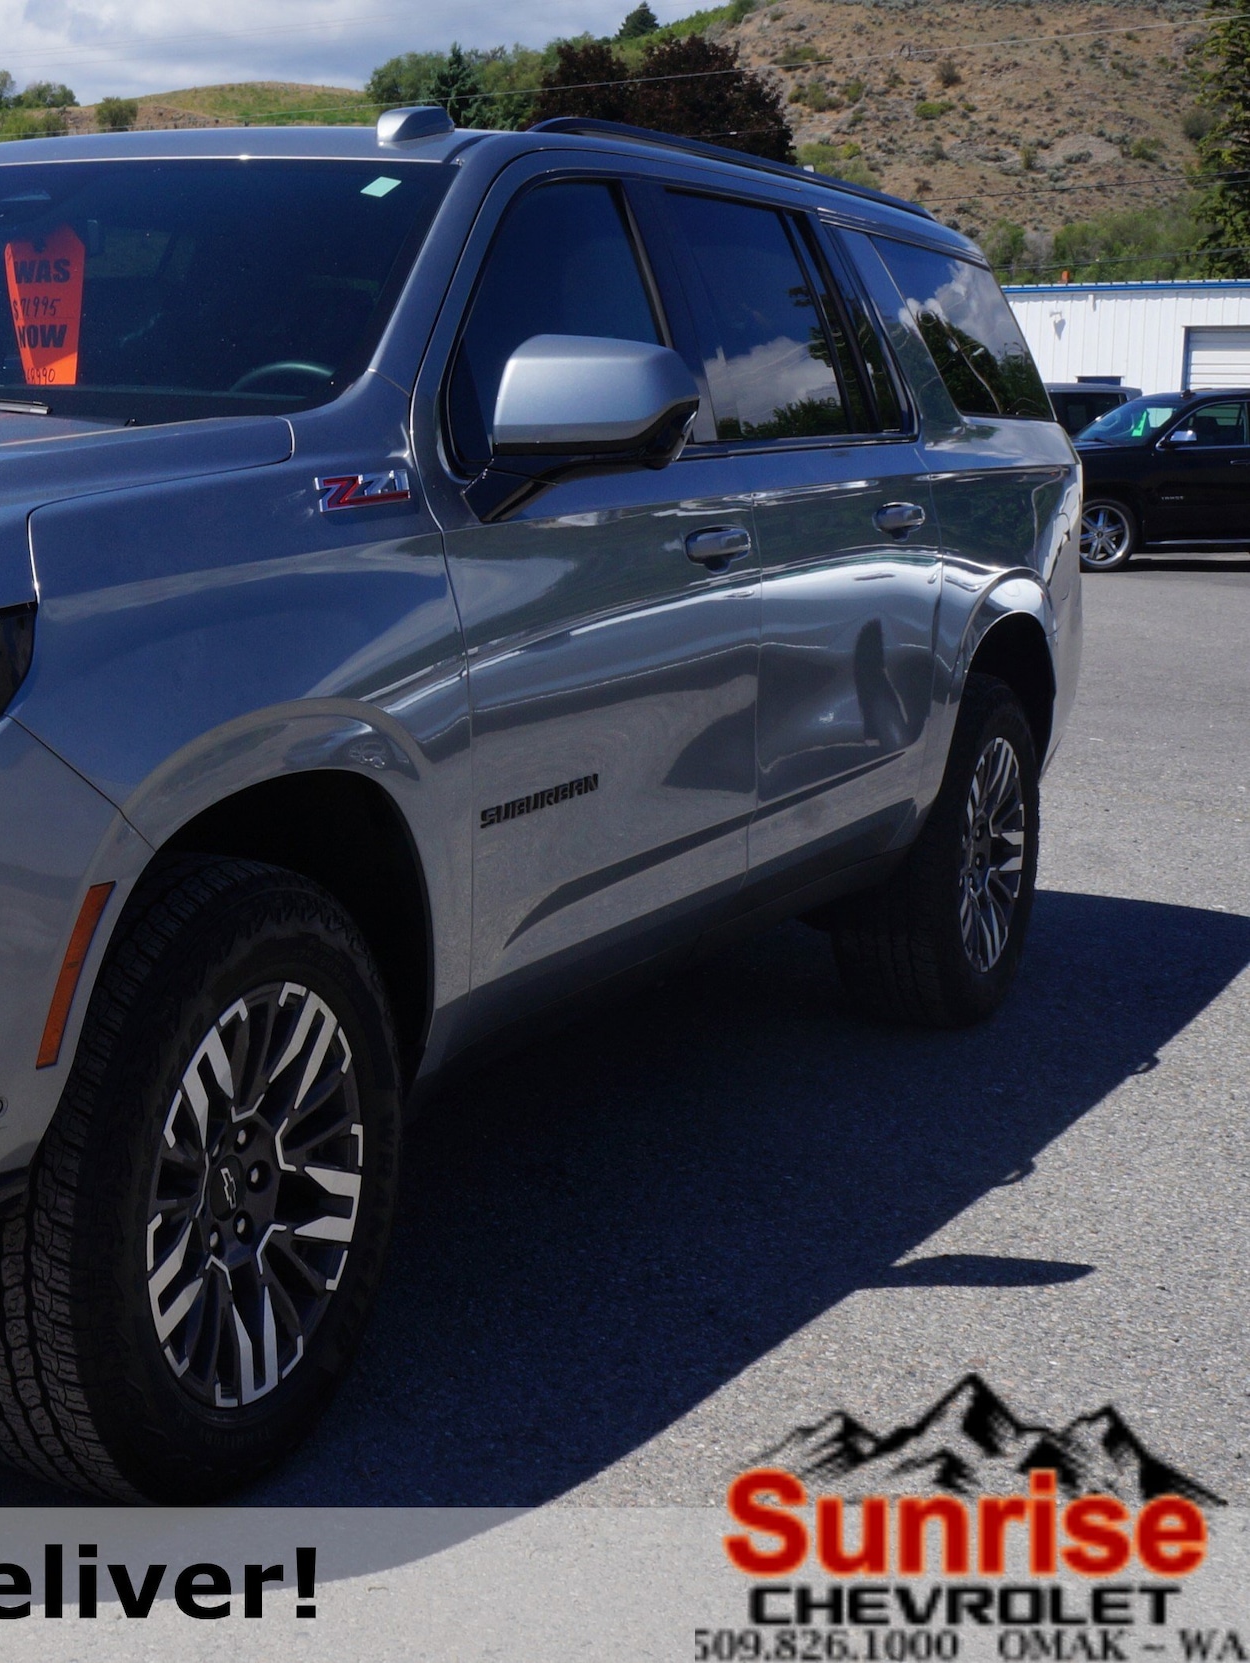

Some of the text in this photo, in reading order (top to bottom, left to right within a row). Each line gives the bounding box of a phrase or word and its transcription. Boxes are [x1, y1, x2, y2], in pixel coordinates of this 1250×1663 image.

[14, 258, 71, 285] WAS
[18, 324, 68, 349] NOW
[314, 469, 410, 513] Z71
[480, 773, 599, 829] SUBURBAN
